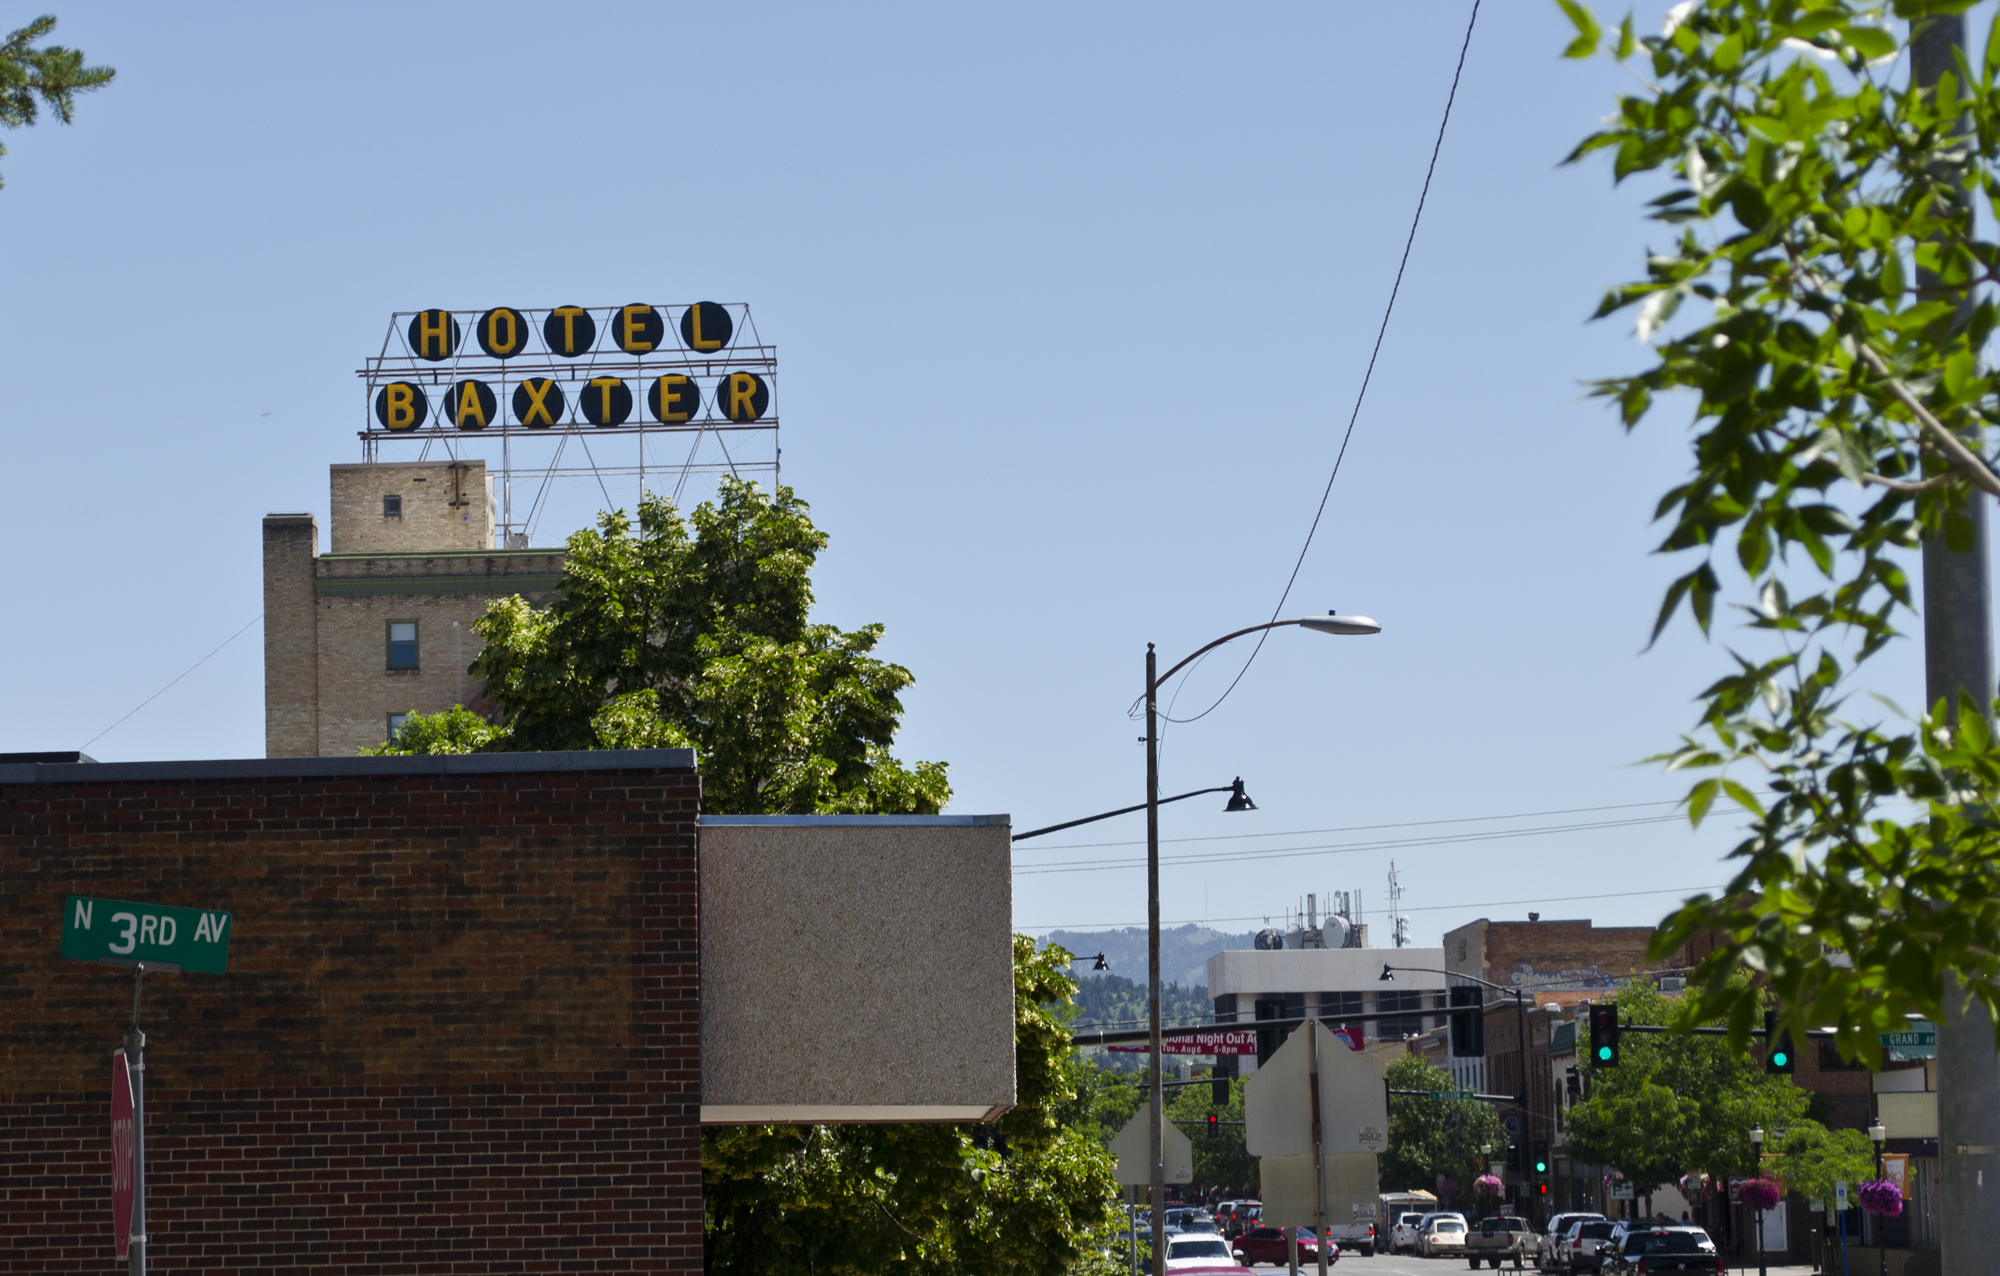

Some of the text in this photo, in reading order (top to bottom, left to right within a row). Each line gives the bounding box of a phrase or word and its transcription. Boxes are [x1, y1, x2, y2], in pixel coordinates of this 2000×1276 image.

[419, 303, 721, 357] HOTEL
[387, 374, 758, 429] BAXTER
[74, 900, 227, 955] N 3RD AV
[1162, 1044, 1178, 1052] Tue.
[1196, 1033, 1224, 1046] Night
[1226, 1032, 1245, 1044] Out
[1890, 1033, 1919, 1045] GRAND
[113, 1118, 132, 1192] STOP
